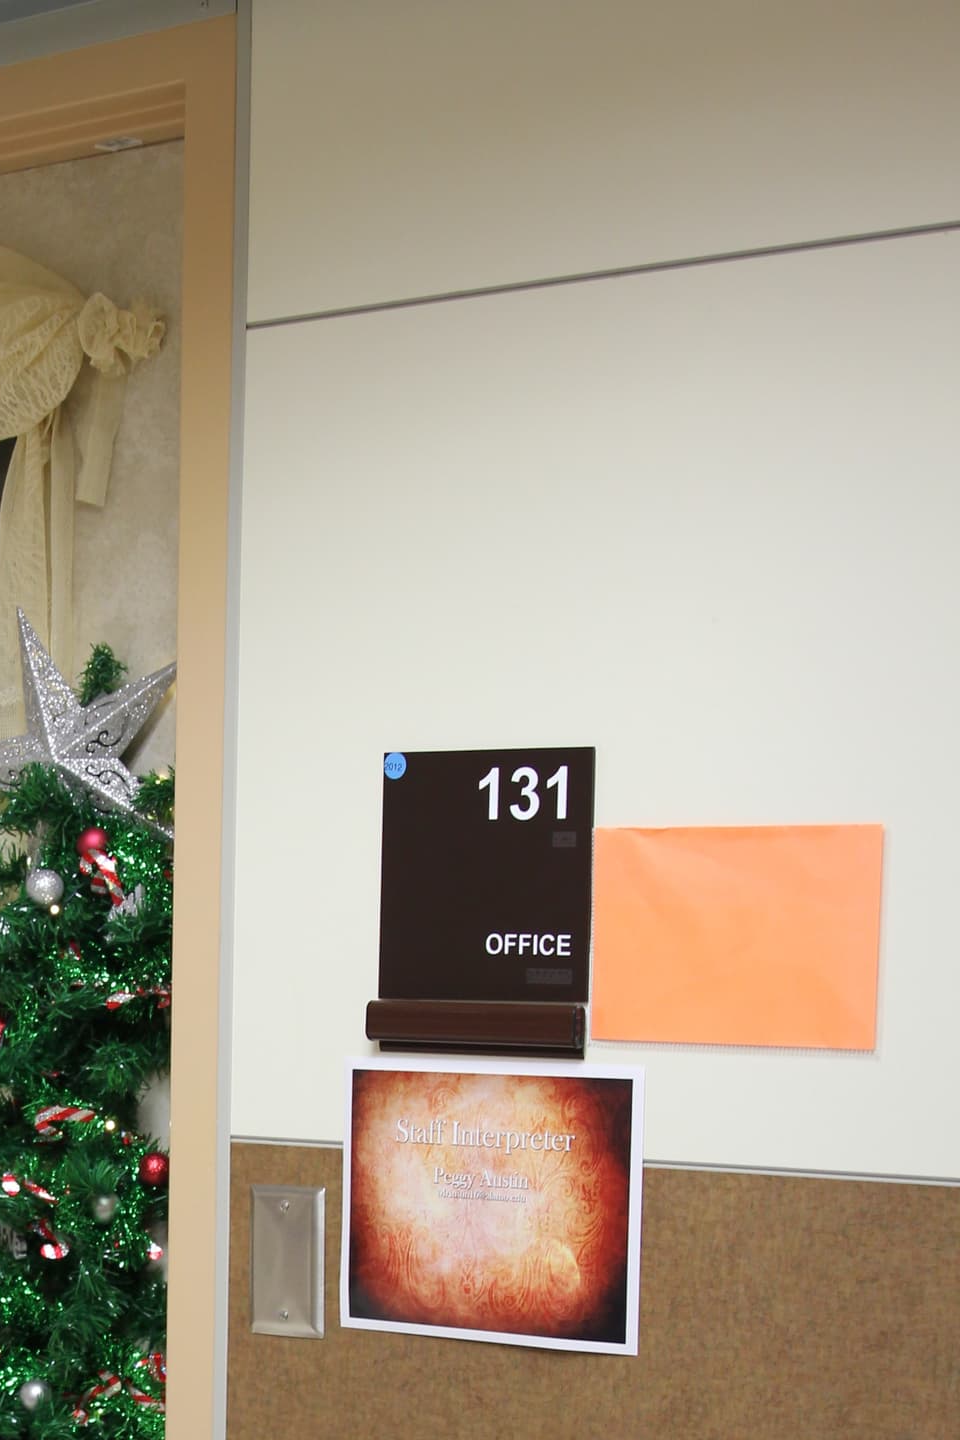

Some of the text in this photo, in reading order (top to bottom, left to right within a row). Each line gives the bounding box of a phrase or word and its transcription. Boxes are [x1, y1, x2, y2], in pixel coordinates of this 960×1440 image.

[478, 765, 569, 821] 131
[485, 933, 572, 956] OFFICE
[395, 1118, 576, 1155] Staff Interpreter
[433, 1166, 529, 1191] Peggy Austin
